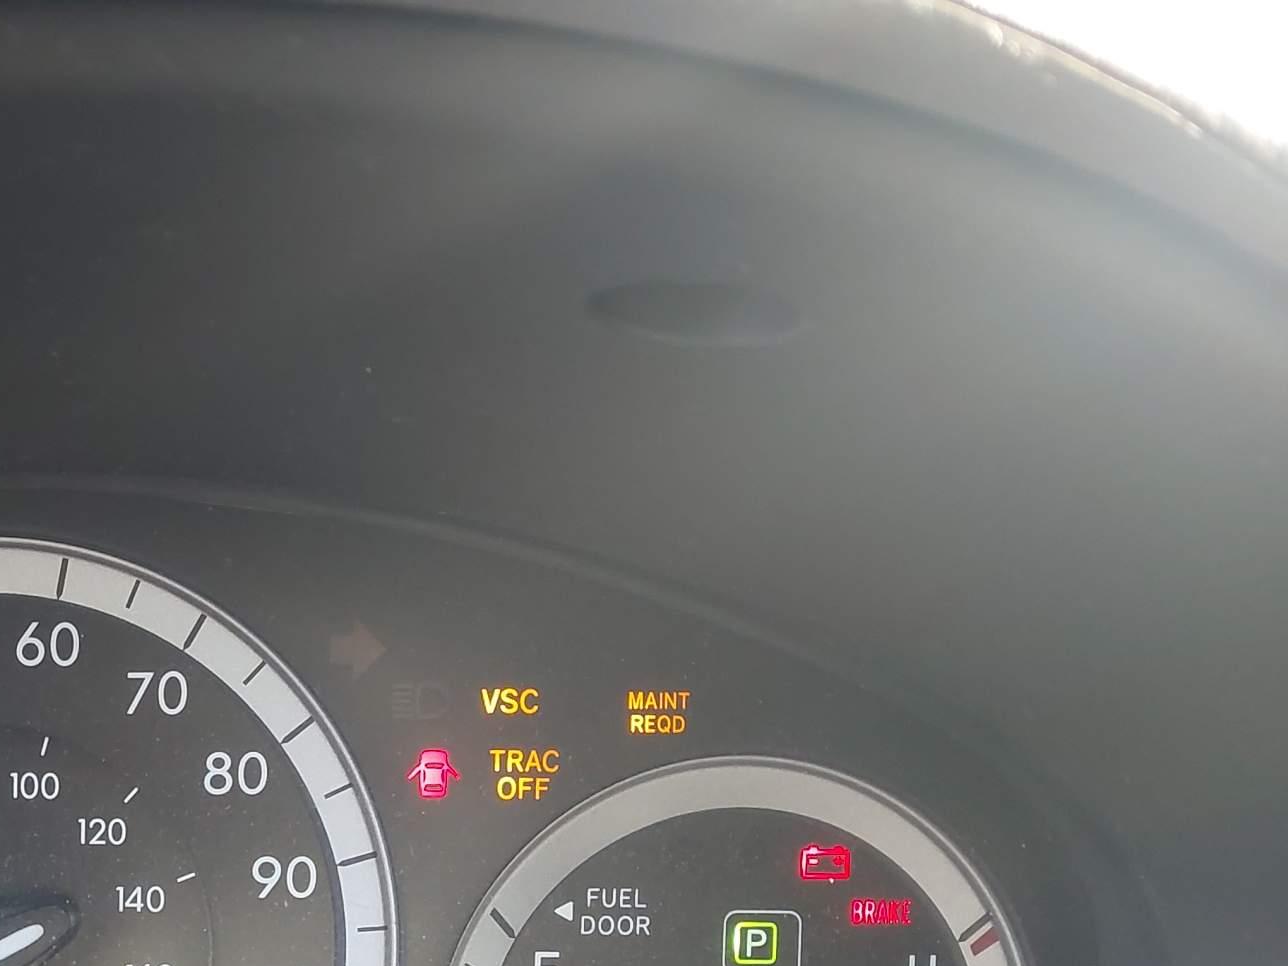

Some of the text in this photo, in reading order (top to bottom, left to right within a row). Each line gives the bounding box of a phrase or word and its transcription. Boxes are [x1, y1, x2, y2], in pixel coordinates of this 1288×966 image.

[17, 622, 79, 666] 60
[127, 671, 187, 715] 70
[482, 689, 538, 713] VSC
[629, 692, 689, 710] MAINT
[631, 715, 685, 733] REQD
[204, 752, 267, 795] 80
[490, 750, 559, 774] TRAC
[10, 773, 59, 799] 100
[498, 777, 549, 799] OFF
[78, 818, 126, 845] 120
[253, 856, 316, 898] 90
[116, 886, 164, 912] 140
[587, 888, 646, 907] FUEL
[851, 900, 912, 924] BRAKE
[581, 916, 649, 935] DOOR
[744, 929, 768, 956] P
